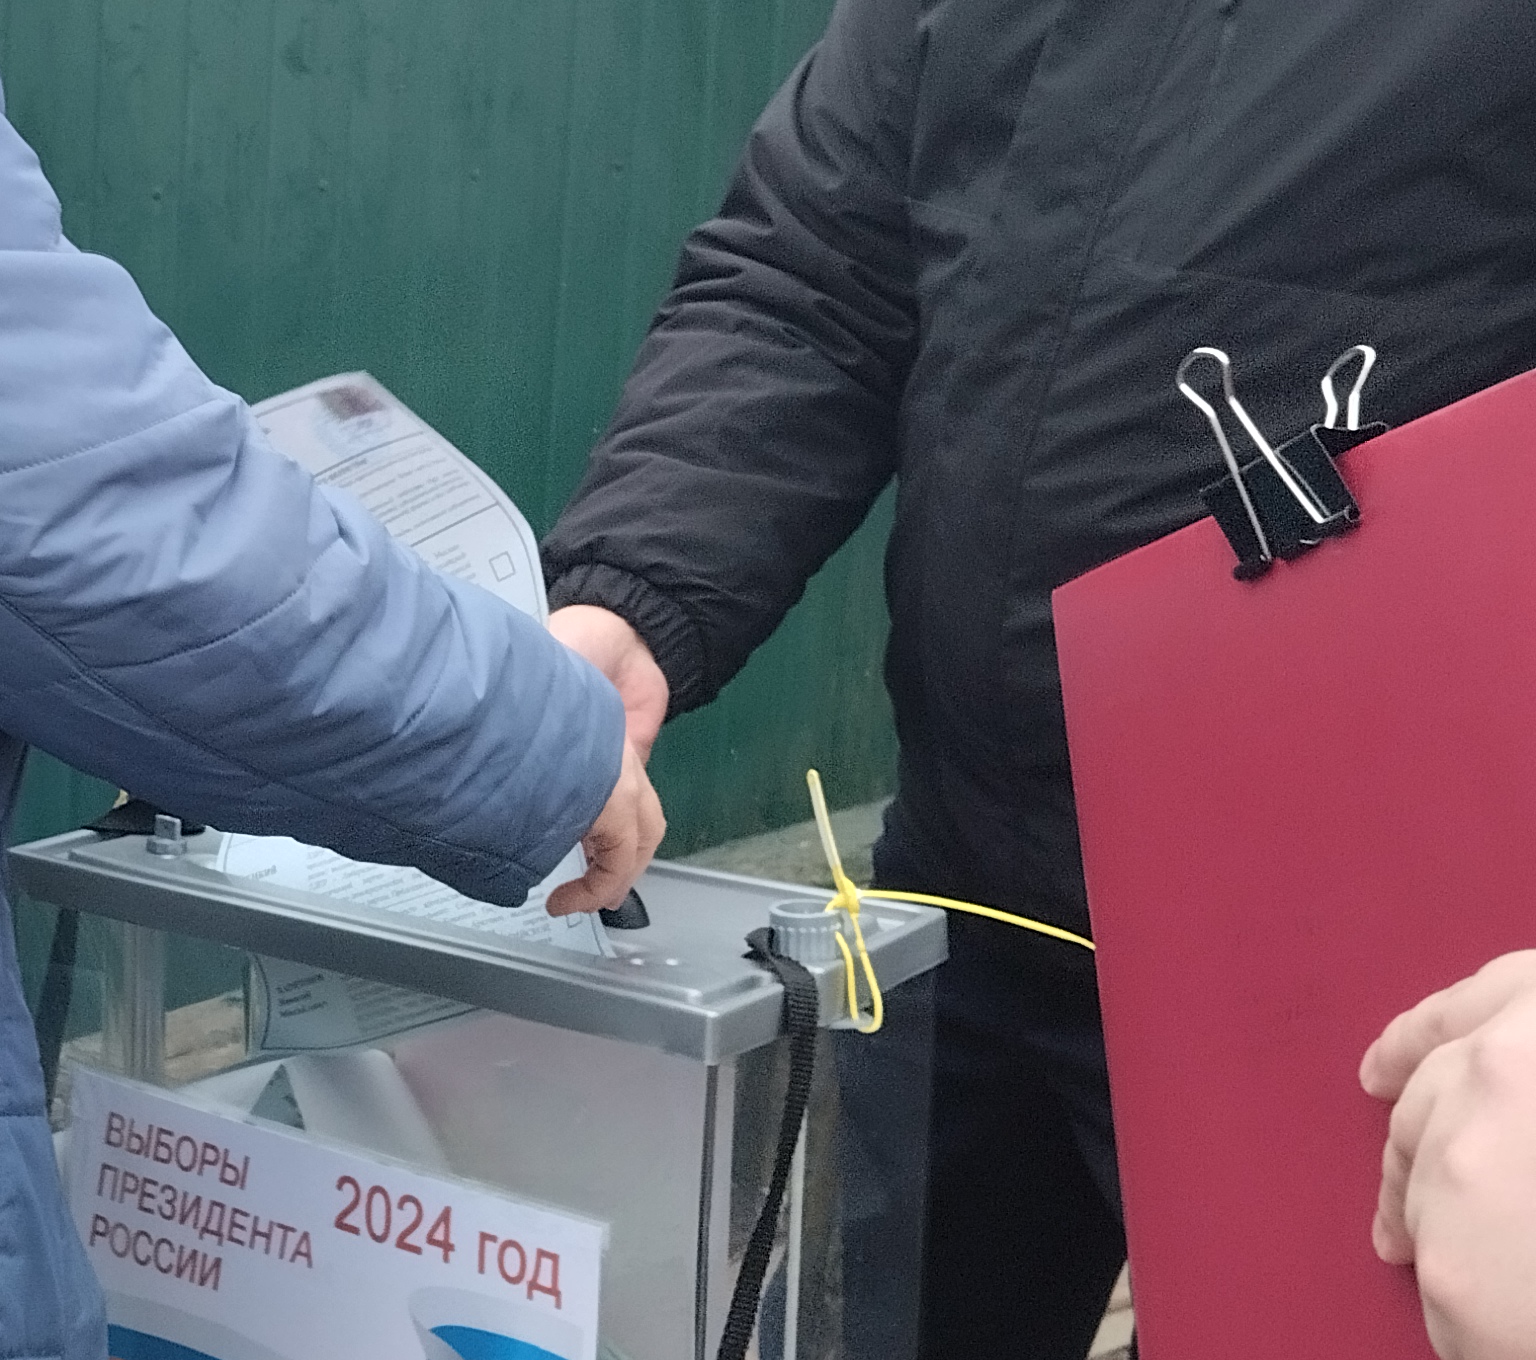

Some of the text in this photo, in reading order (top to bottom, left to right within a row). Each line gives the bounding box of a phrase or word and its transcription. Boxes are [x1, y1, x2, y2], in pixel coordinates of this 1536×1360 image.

[104, 1111, 251, 1190] ВЫБОРЫ
[89, 1213, 222, 1291] РОССИИ
[97, 1162, 313, 1269] ПРЕЗИДЕНТА
[334, 1175, 456, 1264] 2024
